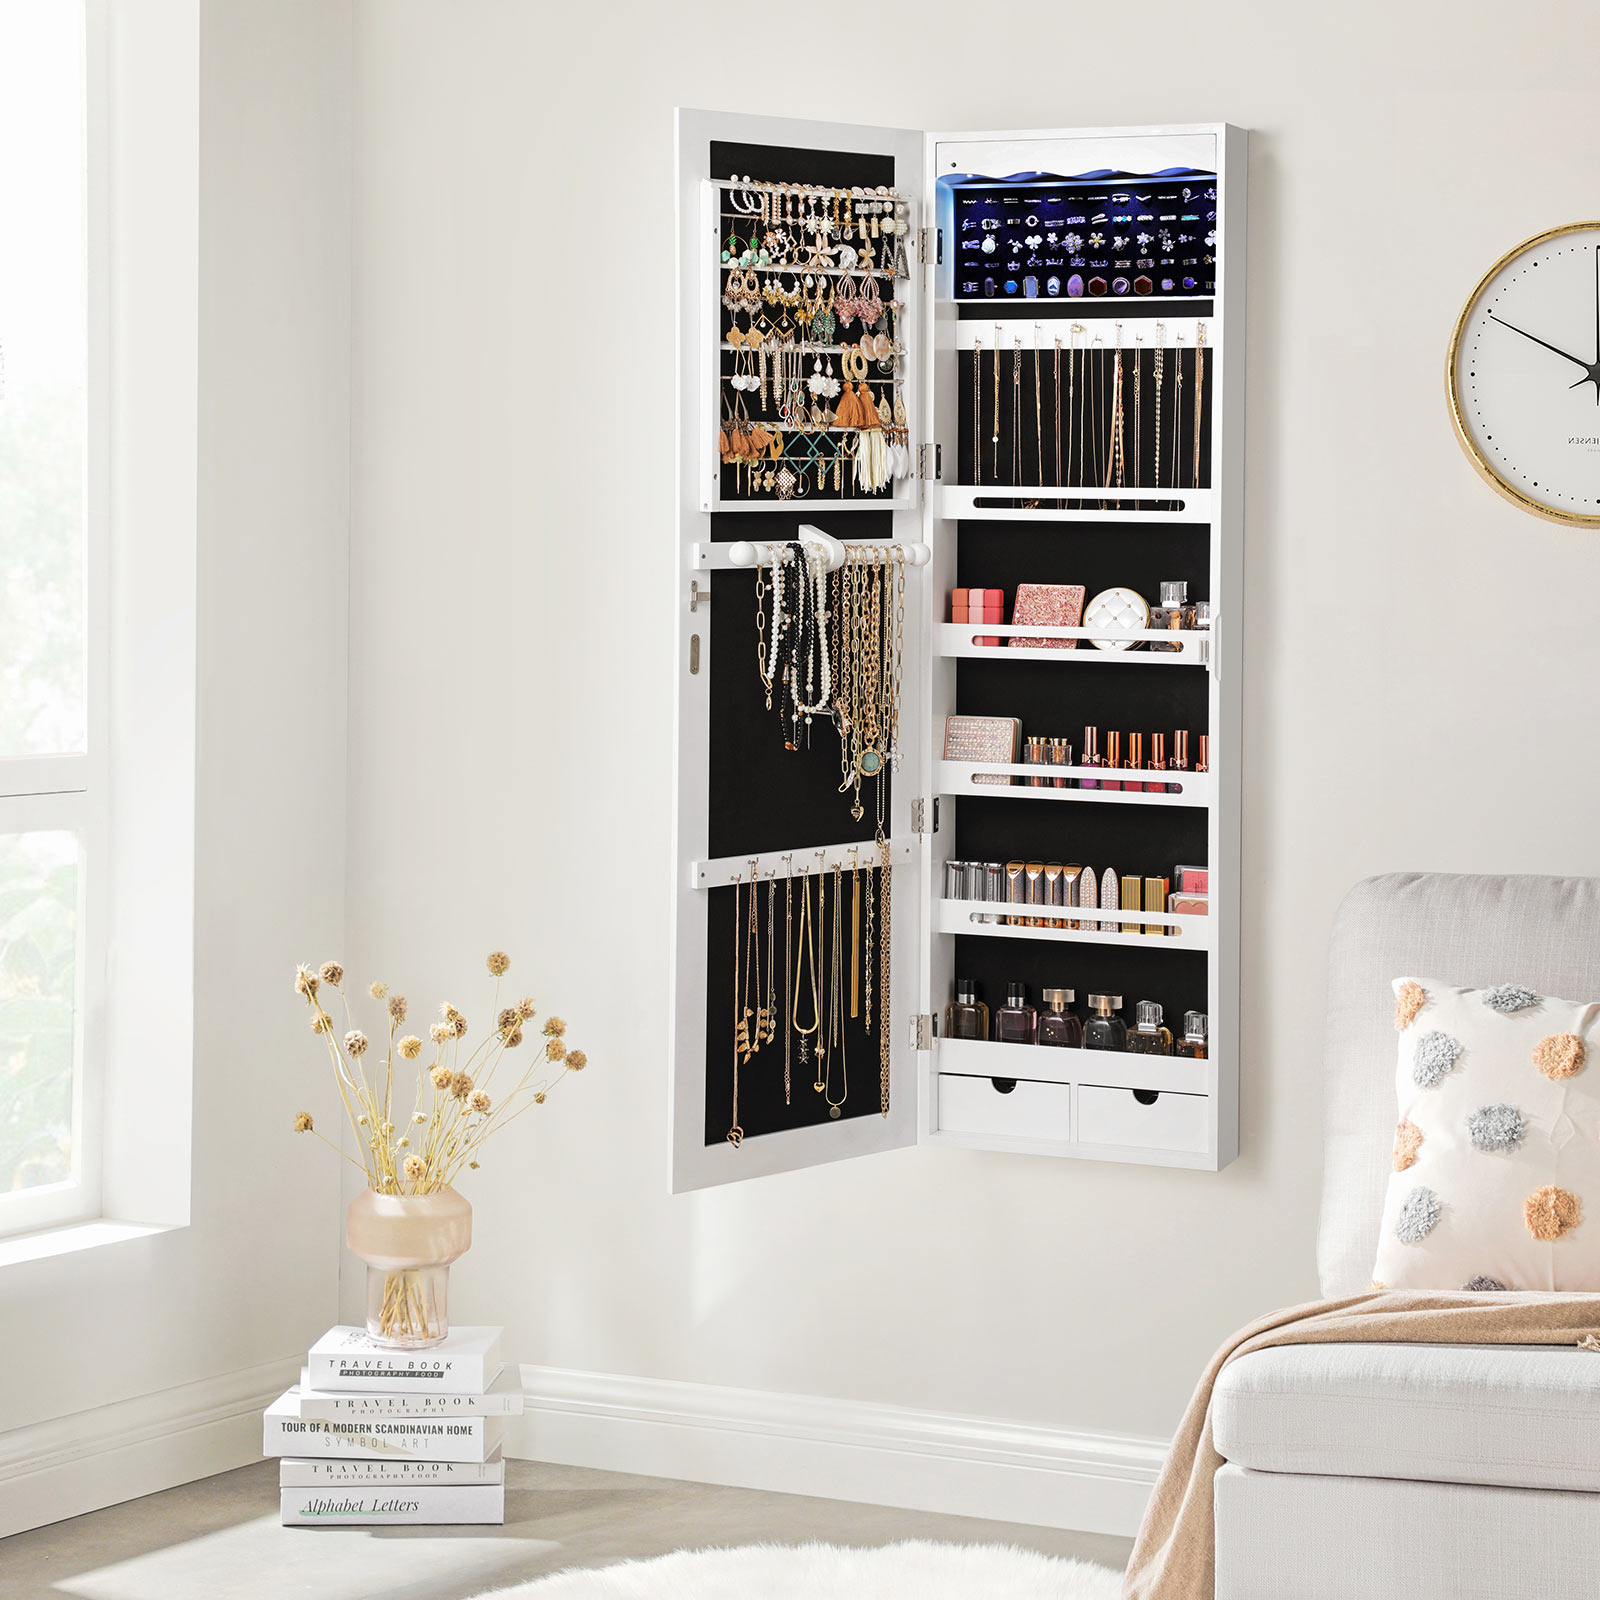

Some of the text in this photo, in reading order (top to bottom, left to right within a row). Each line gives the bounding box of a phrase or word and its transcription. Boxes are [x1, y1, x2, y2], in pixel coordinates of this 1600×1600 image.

[329, 1360, 453, 1370] TRAVEL BOOK
[334, 1397, 475, 1408] TRAVEL BOOK
[281, 1422, 473, 1436] TOUR OF A MODERN SCANDINAVIAN HOME
[325, 1437, 429, 1449] SYMBOL ART
[312, 1463, 454, 1473] TRAVEL BOOK
[302, 1499, 419, 1515] Alphabet Letters
